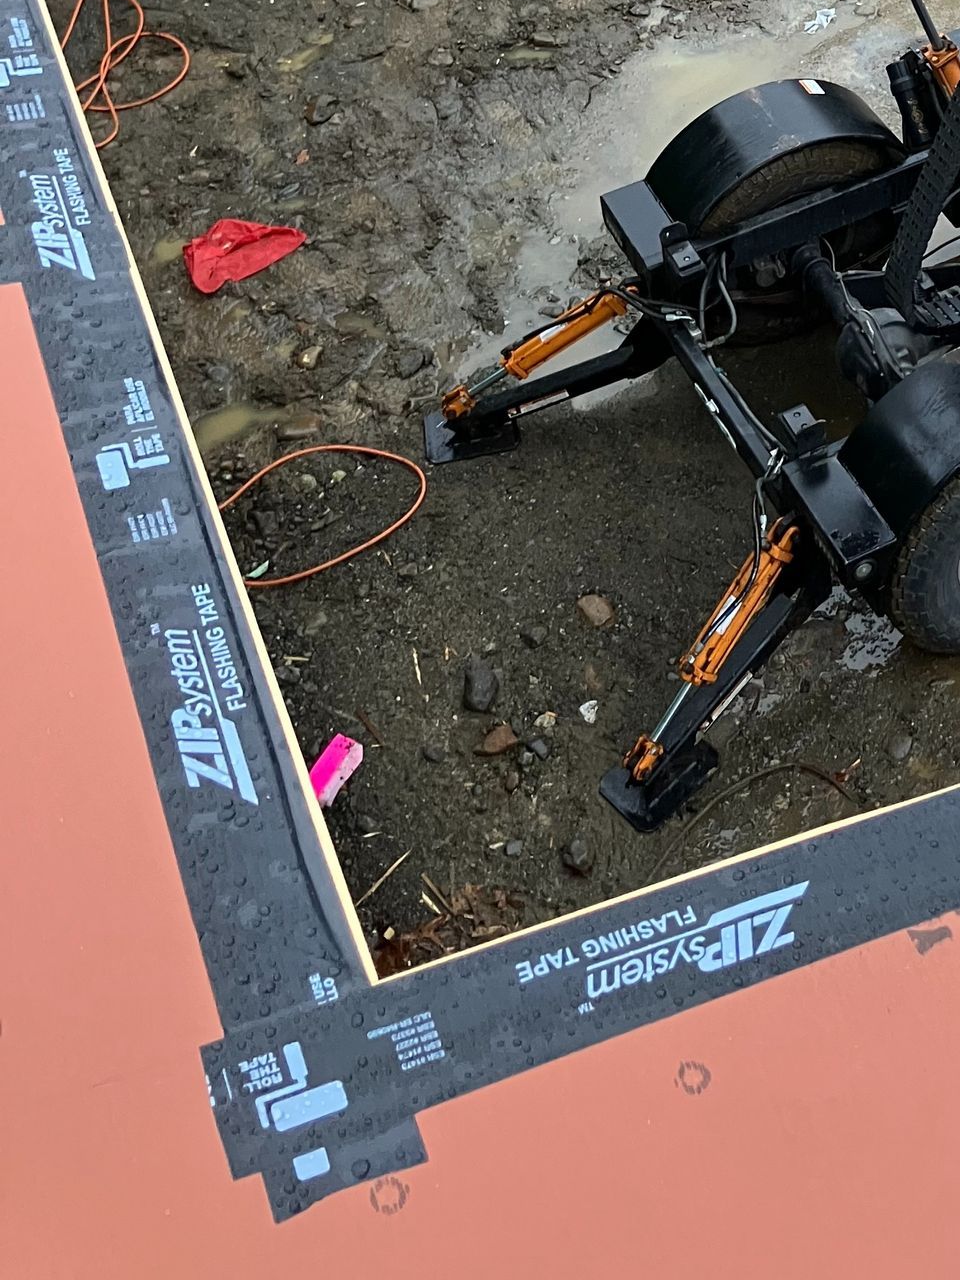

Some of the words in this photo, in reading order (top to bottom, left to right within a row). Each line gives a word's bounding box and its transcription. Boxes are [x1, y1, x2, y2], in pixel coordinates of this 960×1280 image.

[54, 147, 73, 174] TAPE
[191, 582, 217, 627] TAPE
[205, 626, 248, 712] FLASHING
[582, 905, 698, 958] FLASHING
[516, 947, 579, 984] TAPE
[238, 1052, 277, 1072] TAPE
[250, 1064, 281, 1079] THE
[243, 1072, 283, 1093] ROLL
